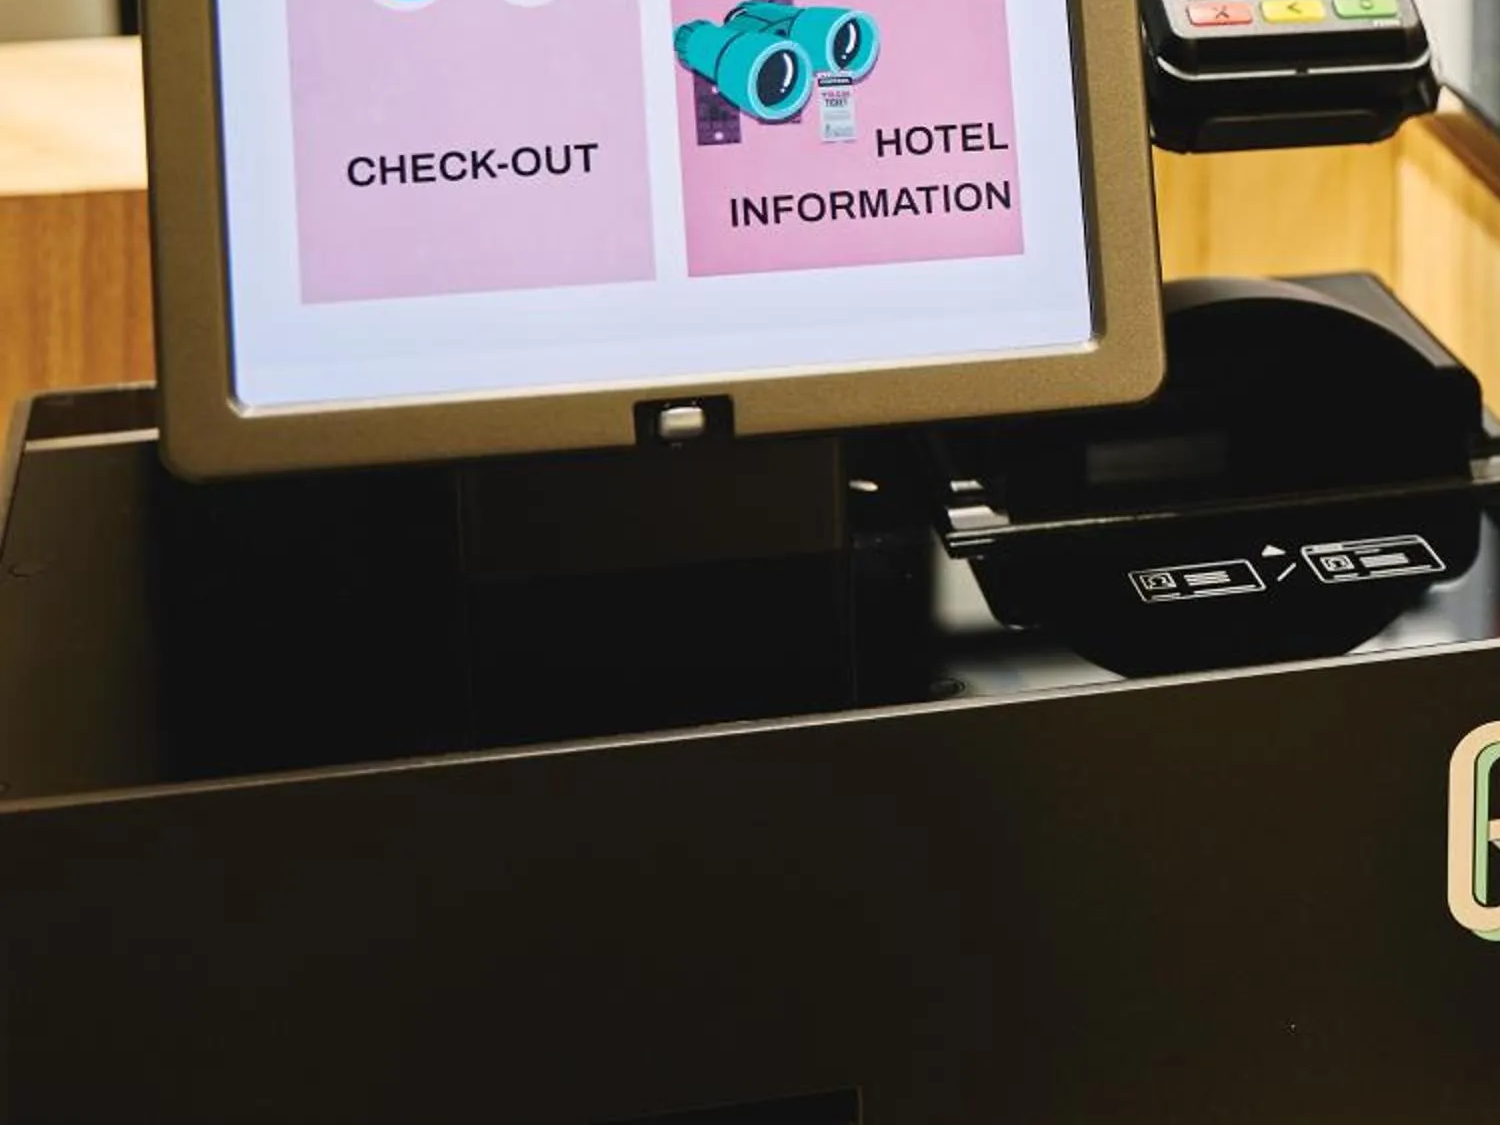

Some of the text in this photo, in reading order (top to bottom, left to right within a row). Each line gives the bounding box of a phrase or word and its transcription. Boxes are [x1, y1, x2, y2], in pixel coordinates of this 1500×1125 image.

[876, 122, 1009, 157] HOTEL
[347, 143, 599, 187] CHECK-OUT
[730, 180, 1012, 228] INFORMATION
